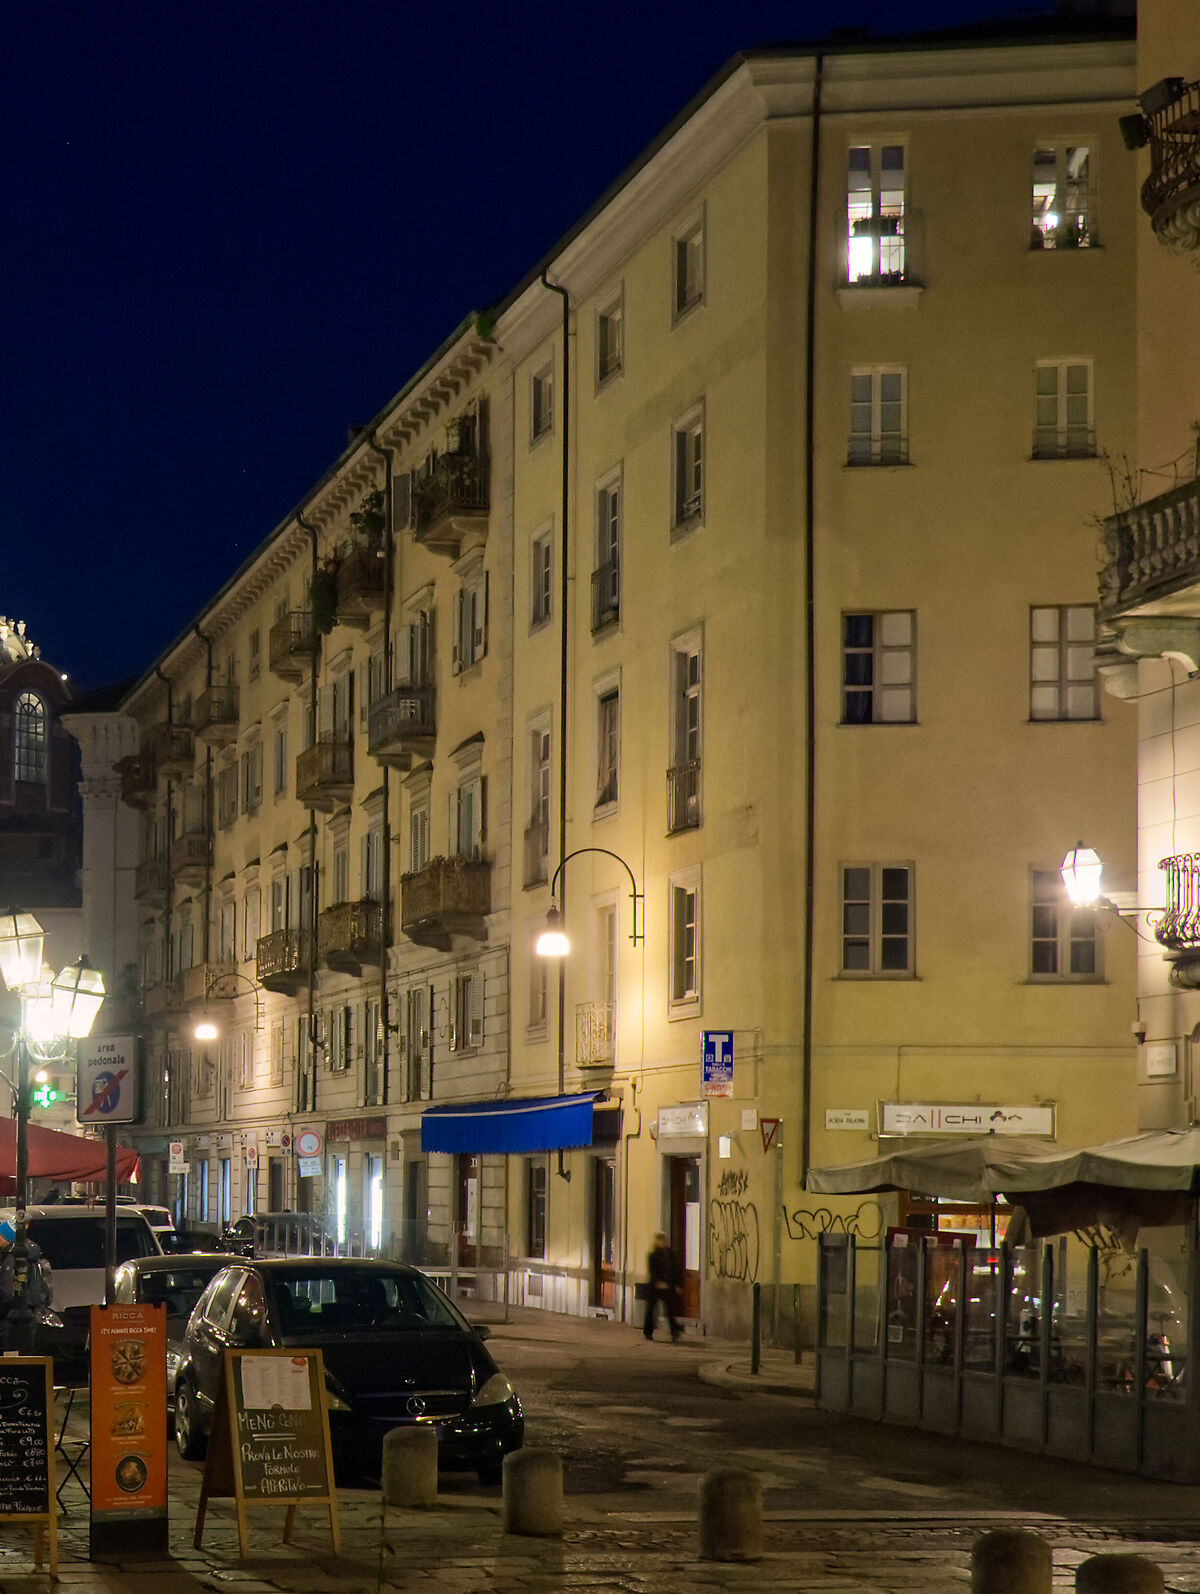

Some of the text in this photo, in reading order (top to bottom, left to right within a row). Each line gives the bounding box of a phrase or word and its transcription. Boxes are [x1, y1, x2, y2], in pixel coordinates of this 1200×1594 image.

[97, 1044, 115, 1053] area
[708, 1034, 729, 1062] T
[88, 1054, 125, 1067] pedonale
[112, 1312, 144, 1320] RICCA
[241, 1443, 320, 1461] PROVA LE NOSTRE
[263, 1462, 300, 1476] FORMULE
[261, 1478, 306, 1495] APERITIVO
